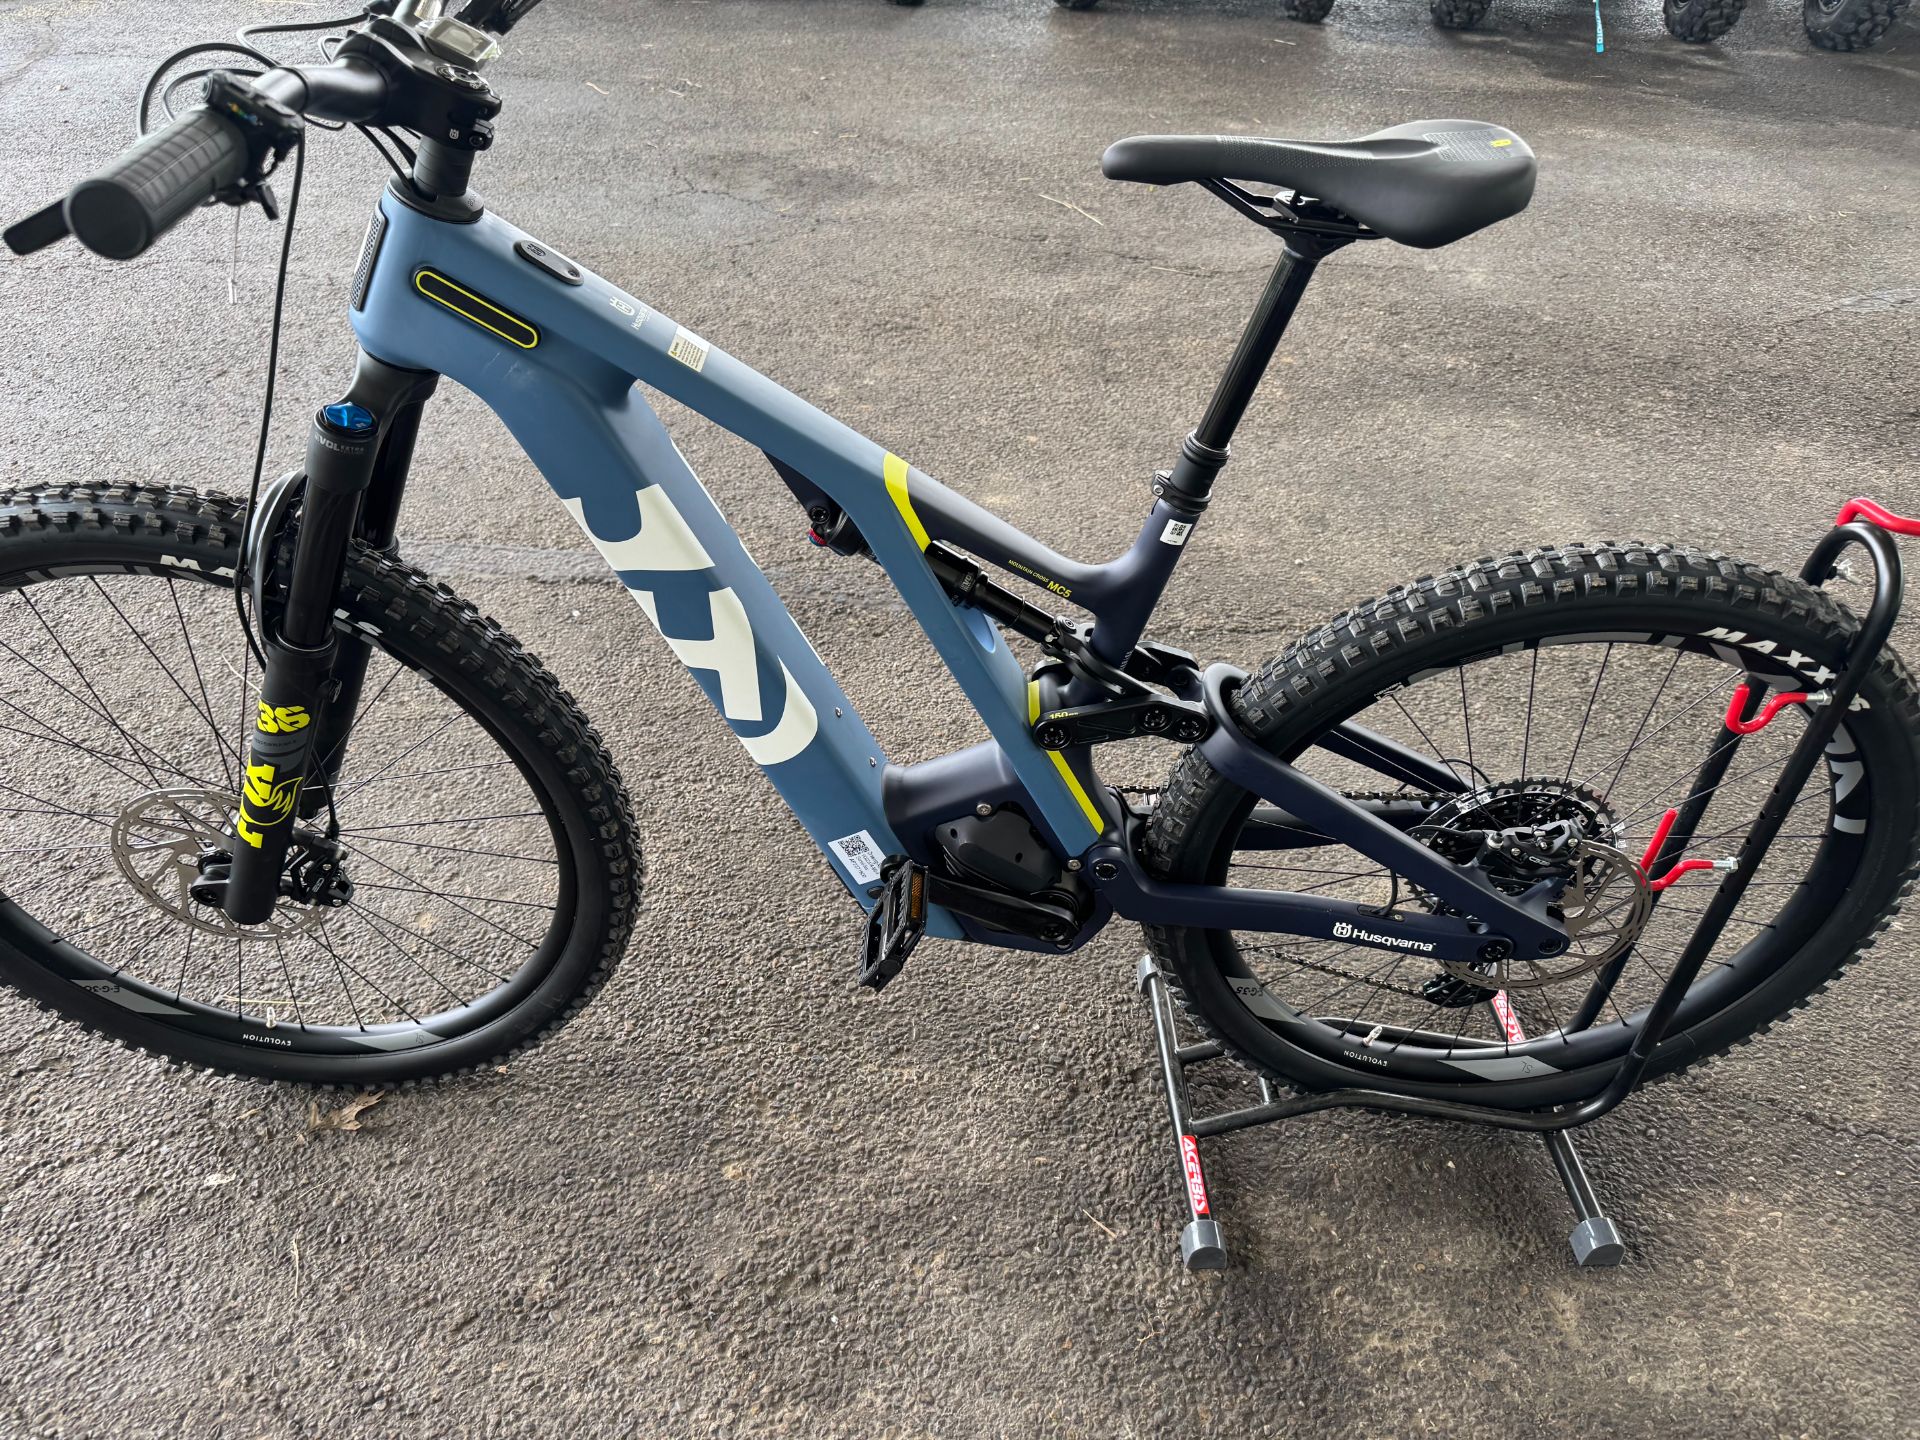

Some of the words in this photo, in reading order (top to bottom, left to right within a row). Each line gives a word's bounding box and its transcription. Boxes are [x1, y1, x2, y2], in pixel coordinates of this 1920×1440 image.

[1008, 559, 1033, 575] MOUNTAIN
[1032, 572, 1050, 583] CROSS
[1046, 580, 1072, 598] MC5
[1697, 626, 1871, 711] MAXXS
[1352, 928, 1435, 951] Husqvarna
[242, 1033, 292, 1046] EVOLUTION
[1343, 1049, 1388, 1067] EVOLUTION
